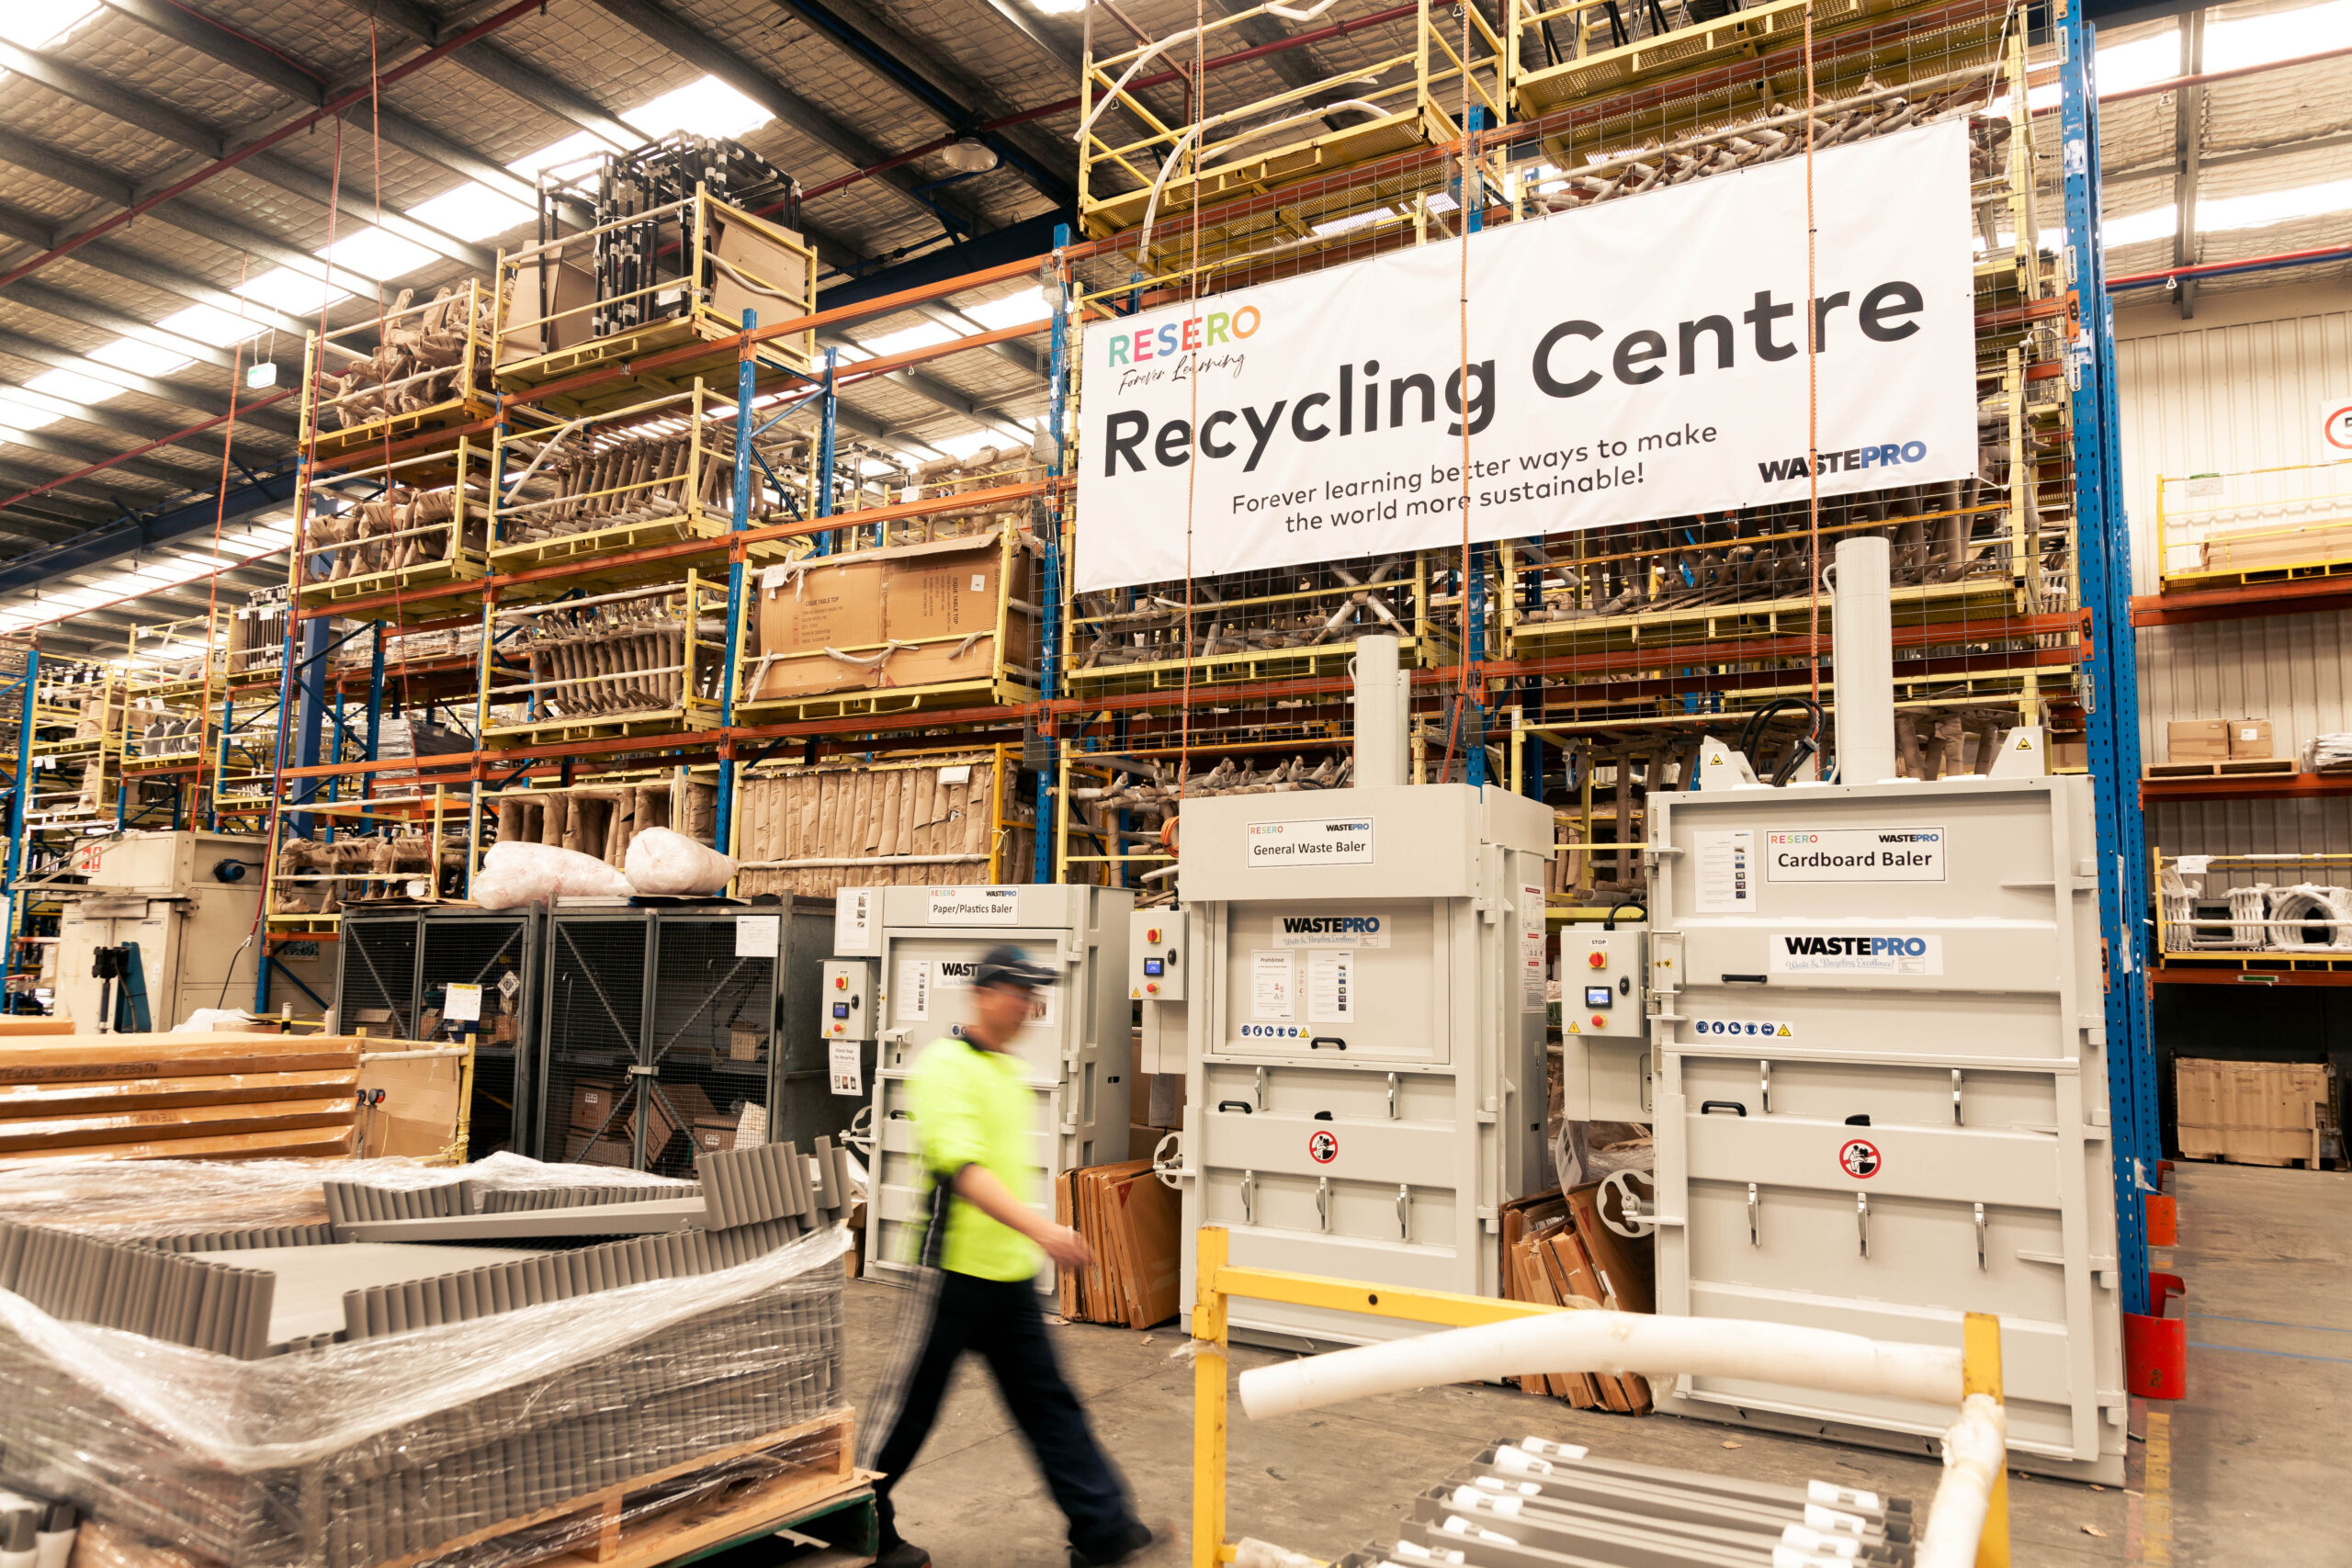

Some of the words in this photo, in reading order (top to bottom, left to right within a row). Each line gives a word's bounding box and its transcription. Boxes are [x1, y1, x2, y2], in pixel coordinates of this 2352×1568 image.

[1109, 305, 1261, 367] RESERO
[1104, 360, 1496, 478] Recycling
[1532, 281, 1924, 399] Centre
[1118, 368, 1165, 395] Forever
[1171, 353, 1246, 381] Learning
[1232, 487, 1317, 514] Forever
[1326, 471, 1422, 501] learning
[1520, 446, 1589, 470] ways
[1598, 439, 1628, 458] to
[1638, 423, 1717, 452] make
[1758, 441, 1928, 483] WASTEPRO
[1285, 512, 1323, 533] the
[1331, 499, 1397, 527] world
[1407, 495, 1471, 516] more
[1480, 462, 1645, 507] sustainable!
[1250, 826, 1283, 835] RESERO
[1326, 823, 1370, 832] WASTEPRO
[1770, 834, 1818, 844] RESERO
[1878, 834, 1939, 843] WASTEPRO
[1253, 843, 1295, 856] General
[1298, 842, 1332, 854] Waste
[1336, 840, 1366, 852] Baler
[1778, 851, 1875, 867] Cardboard
[1883, 851, 1932, 866] Baler
[933, 904, 989, 915] Paper/Plastics
[991, 904, 1012, 913] Baler
[1283, 917, 1380, 933] WASTEPRO
[1784, 937, 1926, 956] WASTEPRO
[942, 963, 978, 976] WAST
[1820, 957, 1855, 969] Recycling
